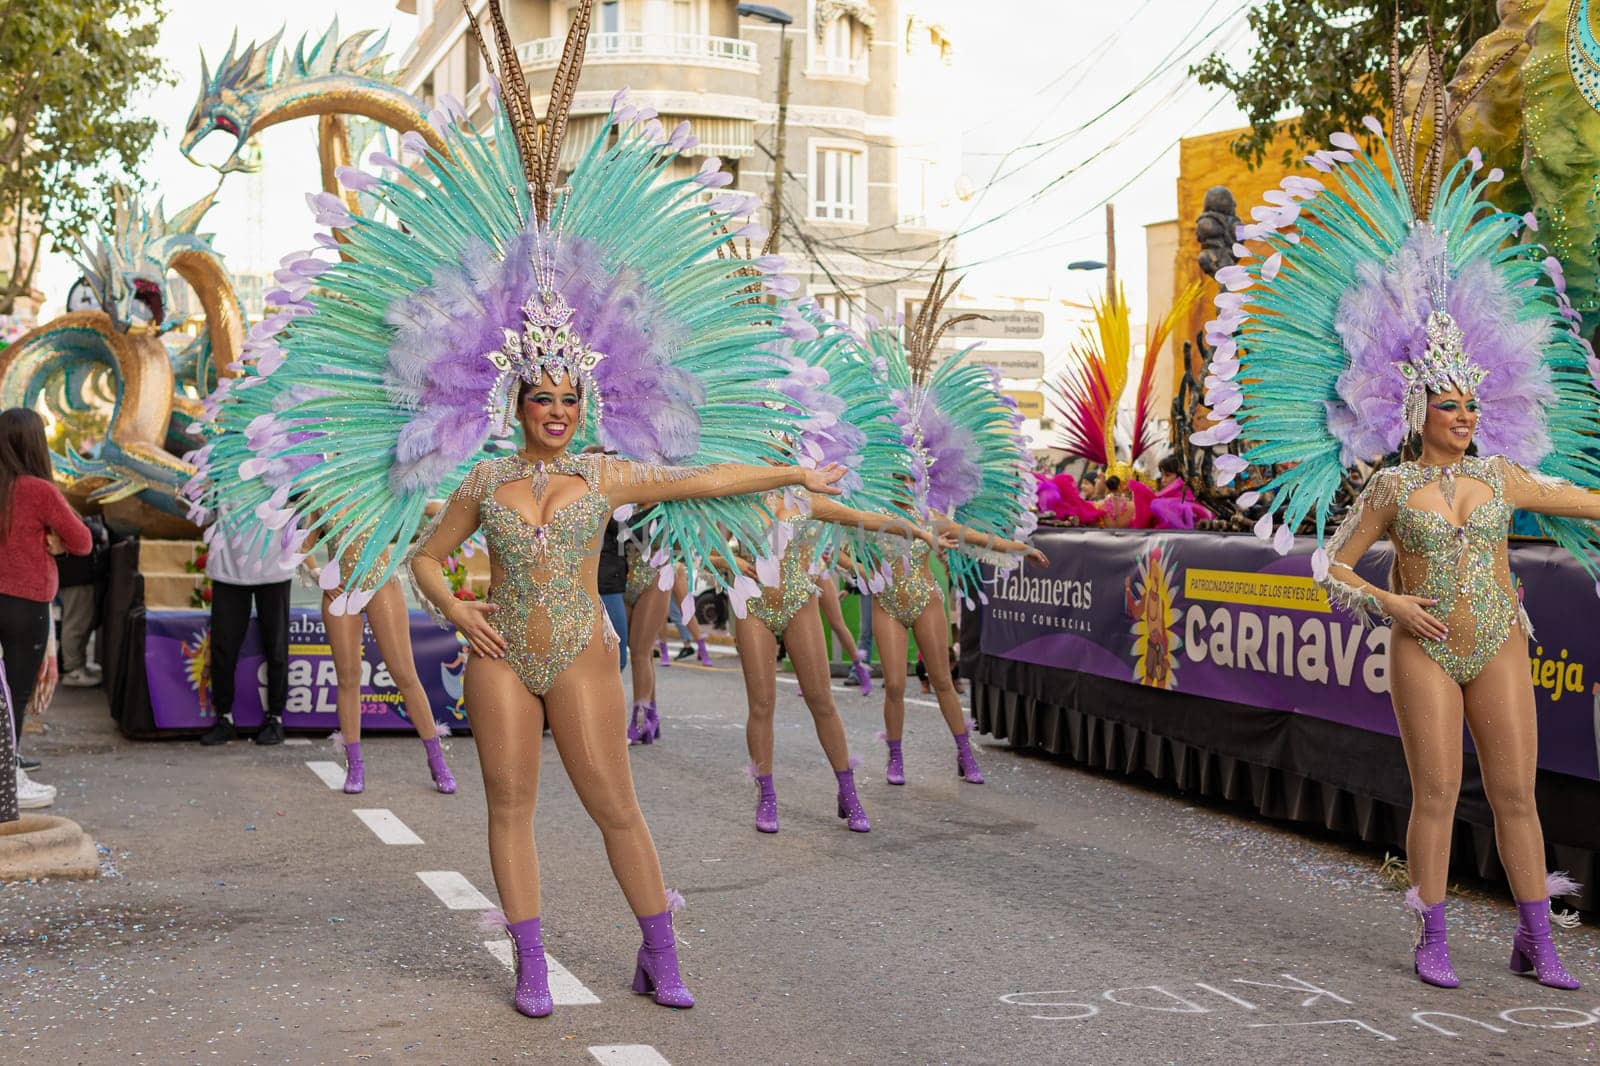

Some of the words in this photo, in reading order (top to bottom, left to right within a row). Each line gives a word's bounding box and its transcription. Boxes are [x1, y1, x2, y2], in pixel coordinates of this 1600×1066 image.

[992, 558, 1092, 610] Habaneras
[1191, 577, 1234, 593] PATROCINADOR
[1234, 582, 1258, 596] OFICIAL
[1259, 584, 1268, 597] DE
[1268, 585, 1282, 598] LOS
[1283, 586, 1305, 601] REYES
[1306, 588, 1320, 602] DEL
[992, 608, 1026, 623] CENTRO
[1032, 614, 1092, 632] COMERCIAL
